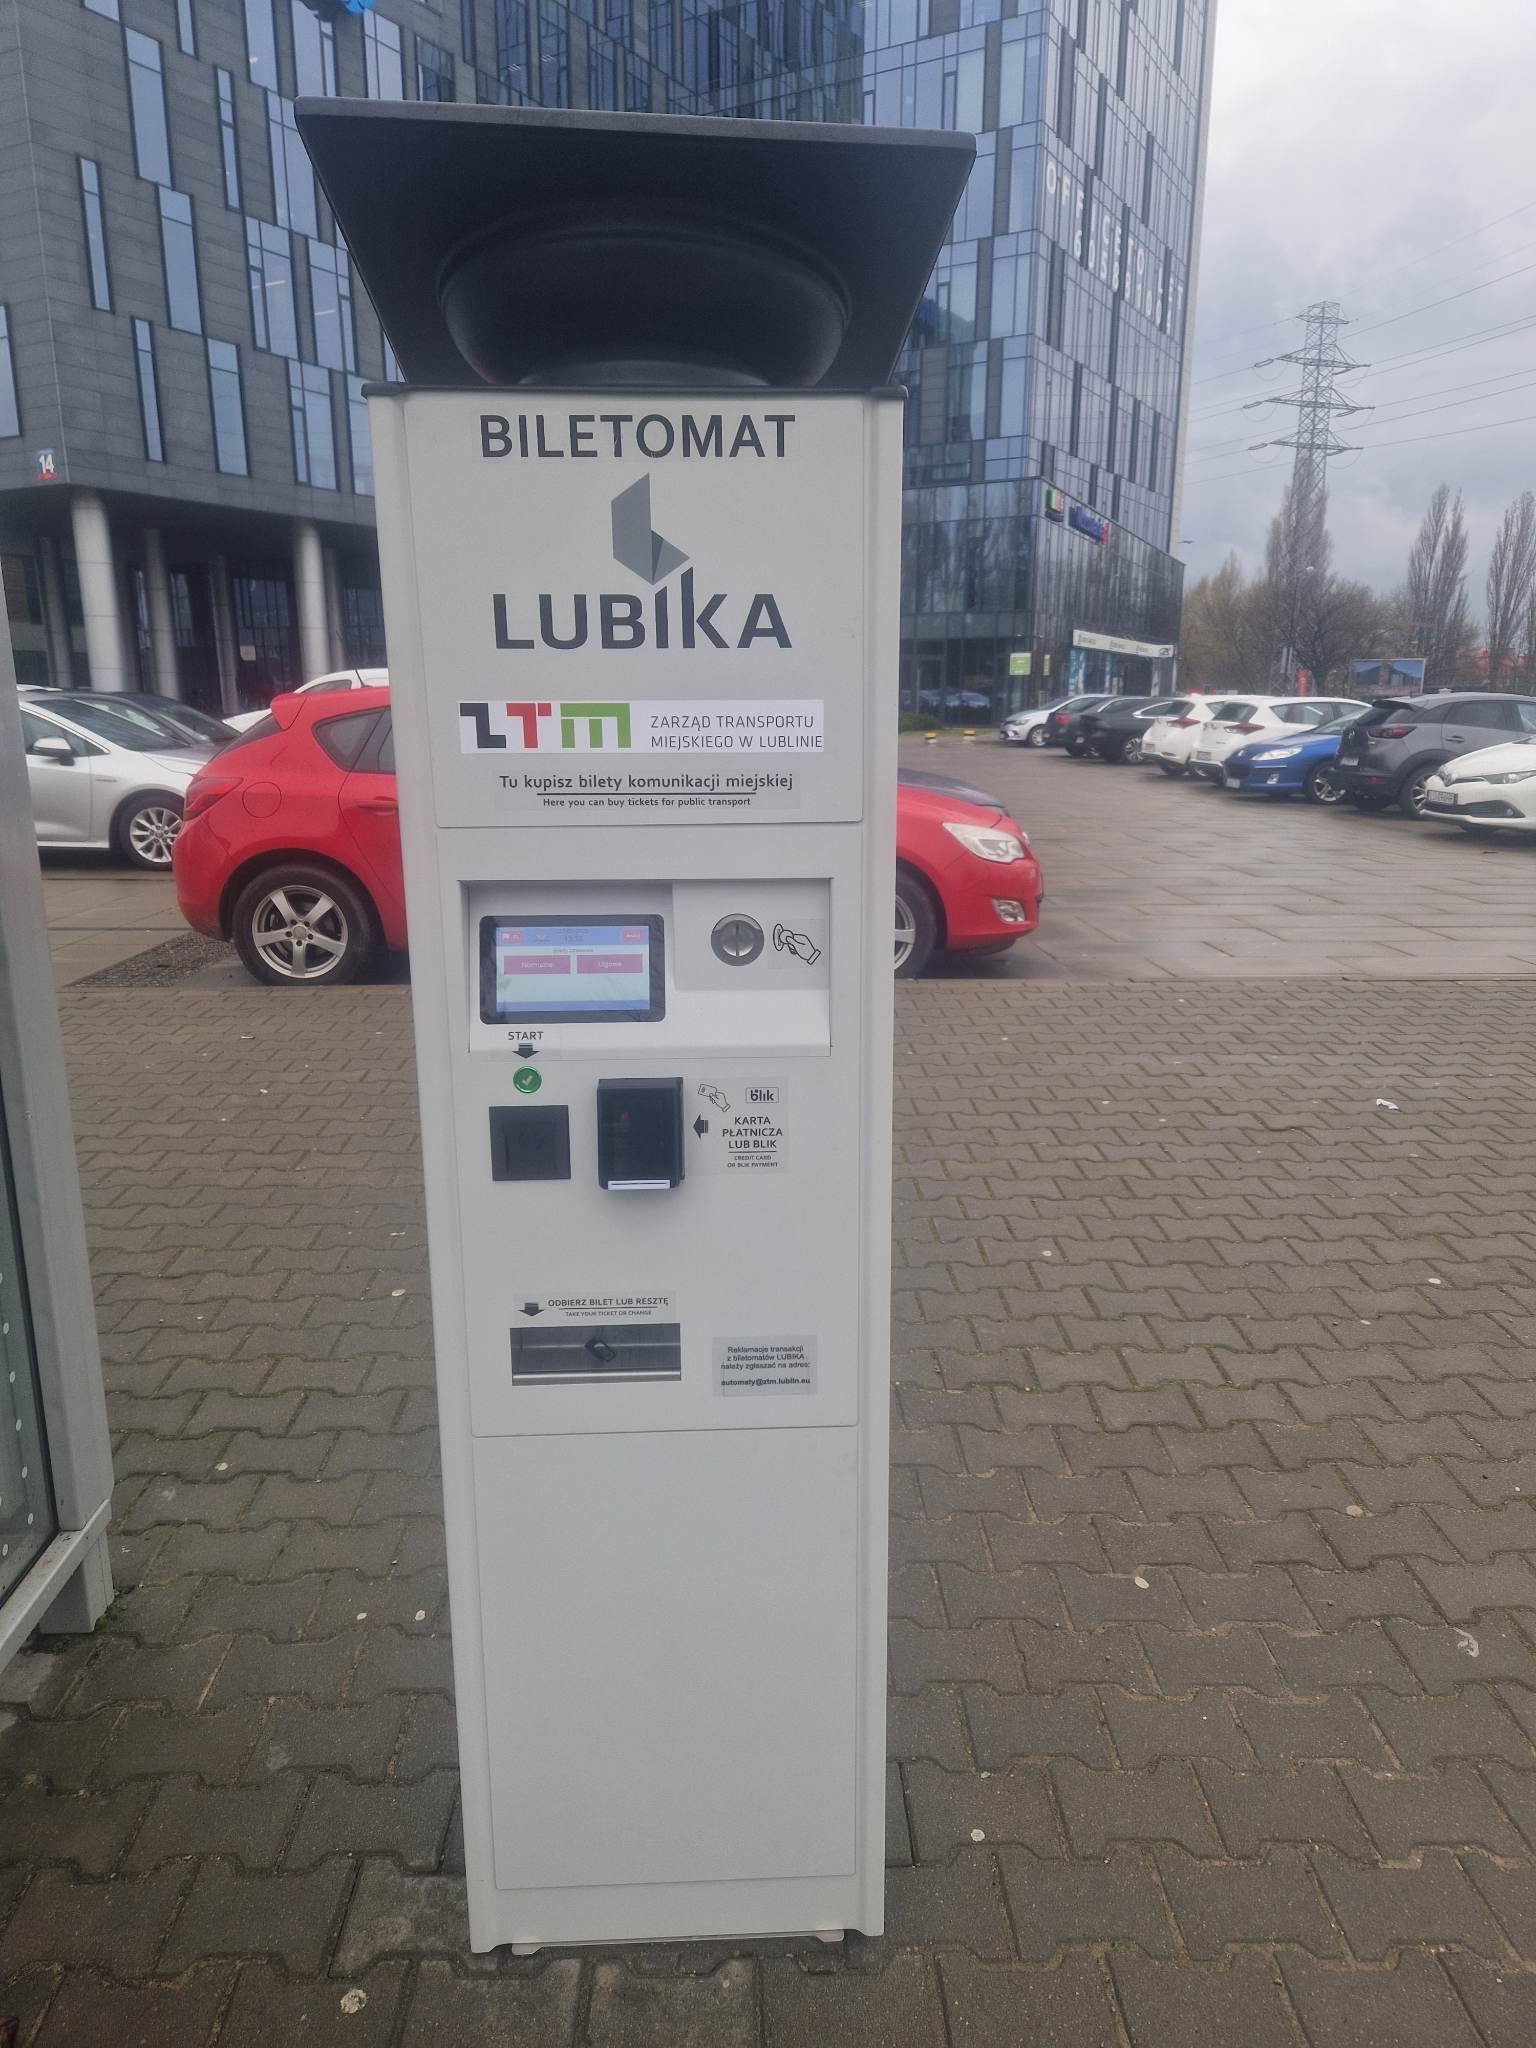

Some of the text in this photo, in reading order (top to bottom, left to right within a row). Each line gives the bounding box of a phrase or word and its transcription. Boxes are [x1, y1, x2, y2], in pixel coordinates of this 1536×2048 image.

[1046, 161, 1184, 310] OFFICE TO LET
[479, 413, 796, 458] BILETOMAT
[39, 453, 55, 474] 14
[492, 566, 793, 650] LUBIKA
[650, 714, 814, 731] ZARZĄD TRANSPORTU
[650, 734, 823, 751] MIEJSKIEGO W LUBLINIE
[499, 772, 793, 791] Tu kupisz bilety komunikacji miejskiej
[542, 797, 751, 808] Here you can buy tickets for public transport
[507, 1031, 545, 1041] START
[750, 1089, 775, 1102] blik
[734, 1116, 771, 1125] KARTA
[721, 1127, 784, 1137] PŁATNICZA
[728, 1139, 777, 1149] LUB BLIK
[547, 1297, 669, 1307] ODBIERZ BILET LUB RESZTĘ
[727, 1345, 804, 1354] Reklamacje transakcji
[720, 1363, 744, 1371] należy
[745, 1362, 776, 1370] zgłaszać
[721, 1378, 811, 1387] automaty@ztm.lublin.eu
